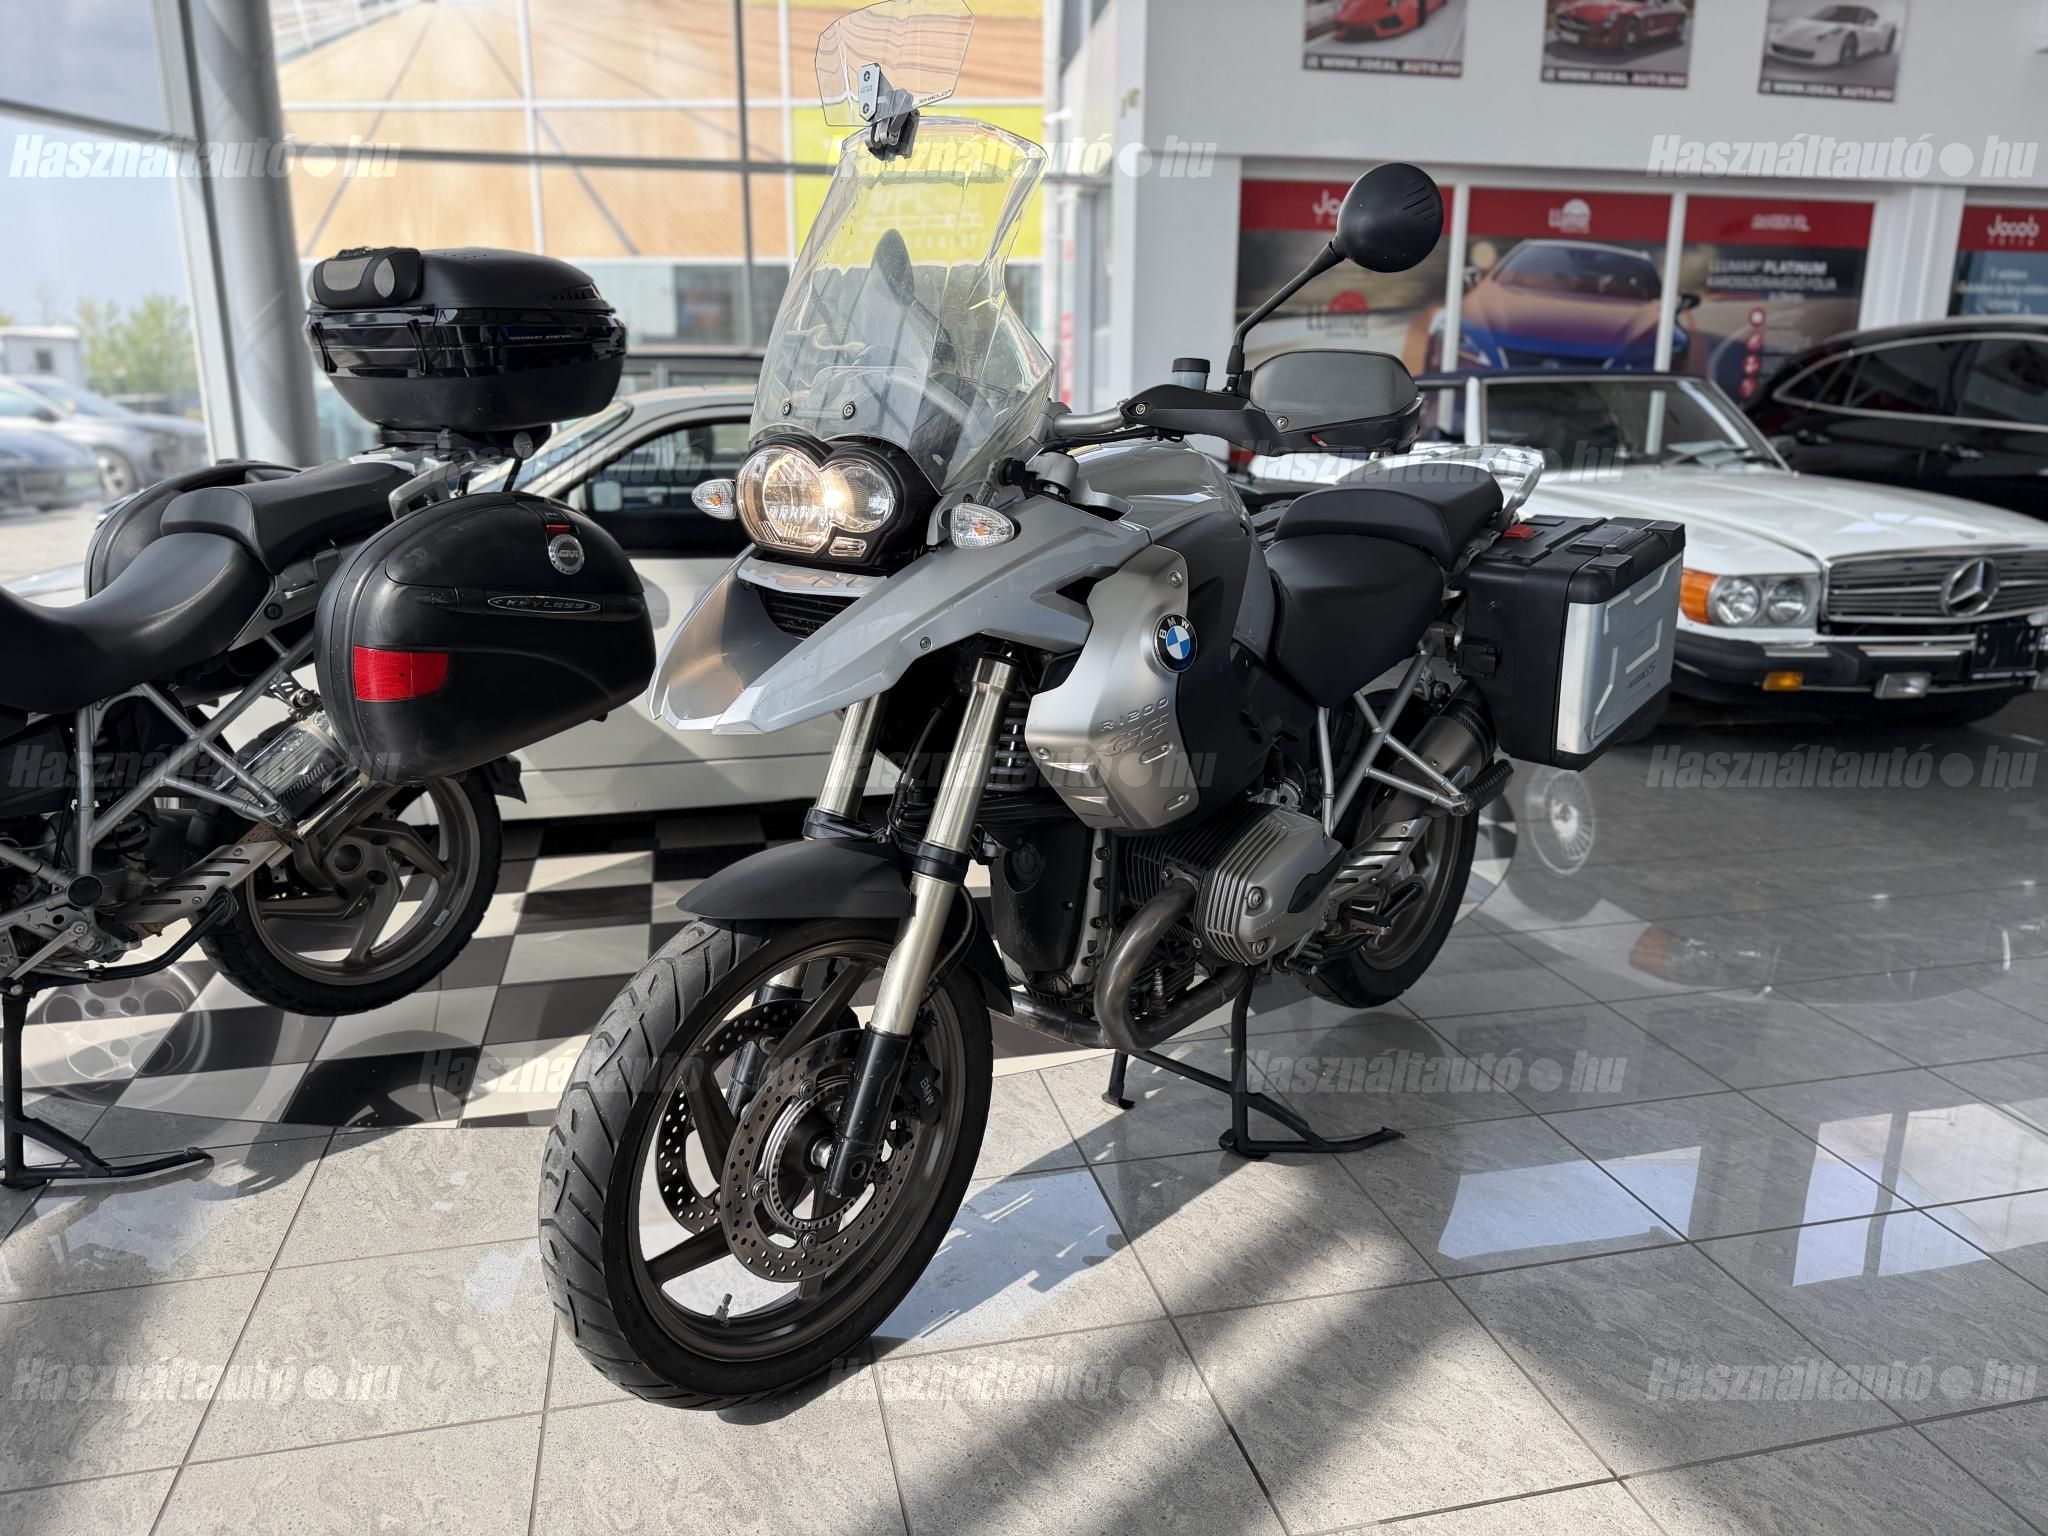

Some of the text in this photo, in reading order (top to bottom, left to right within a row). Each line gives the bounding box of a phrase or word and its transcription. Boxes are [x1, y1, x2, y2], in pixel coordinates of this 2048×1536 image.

[558, 549, 579, 558] GIVI
[506, 599, 586, 610] KEYLESS
[1158, 616, 1190, 640] BMW
